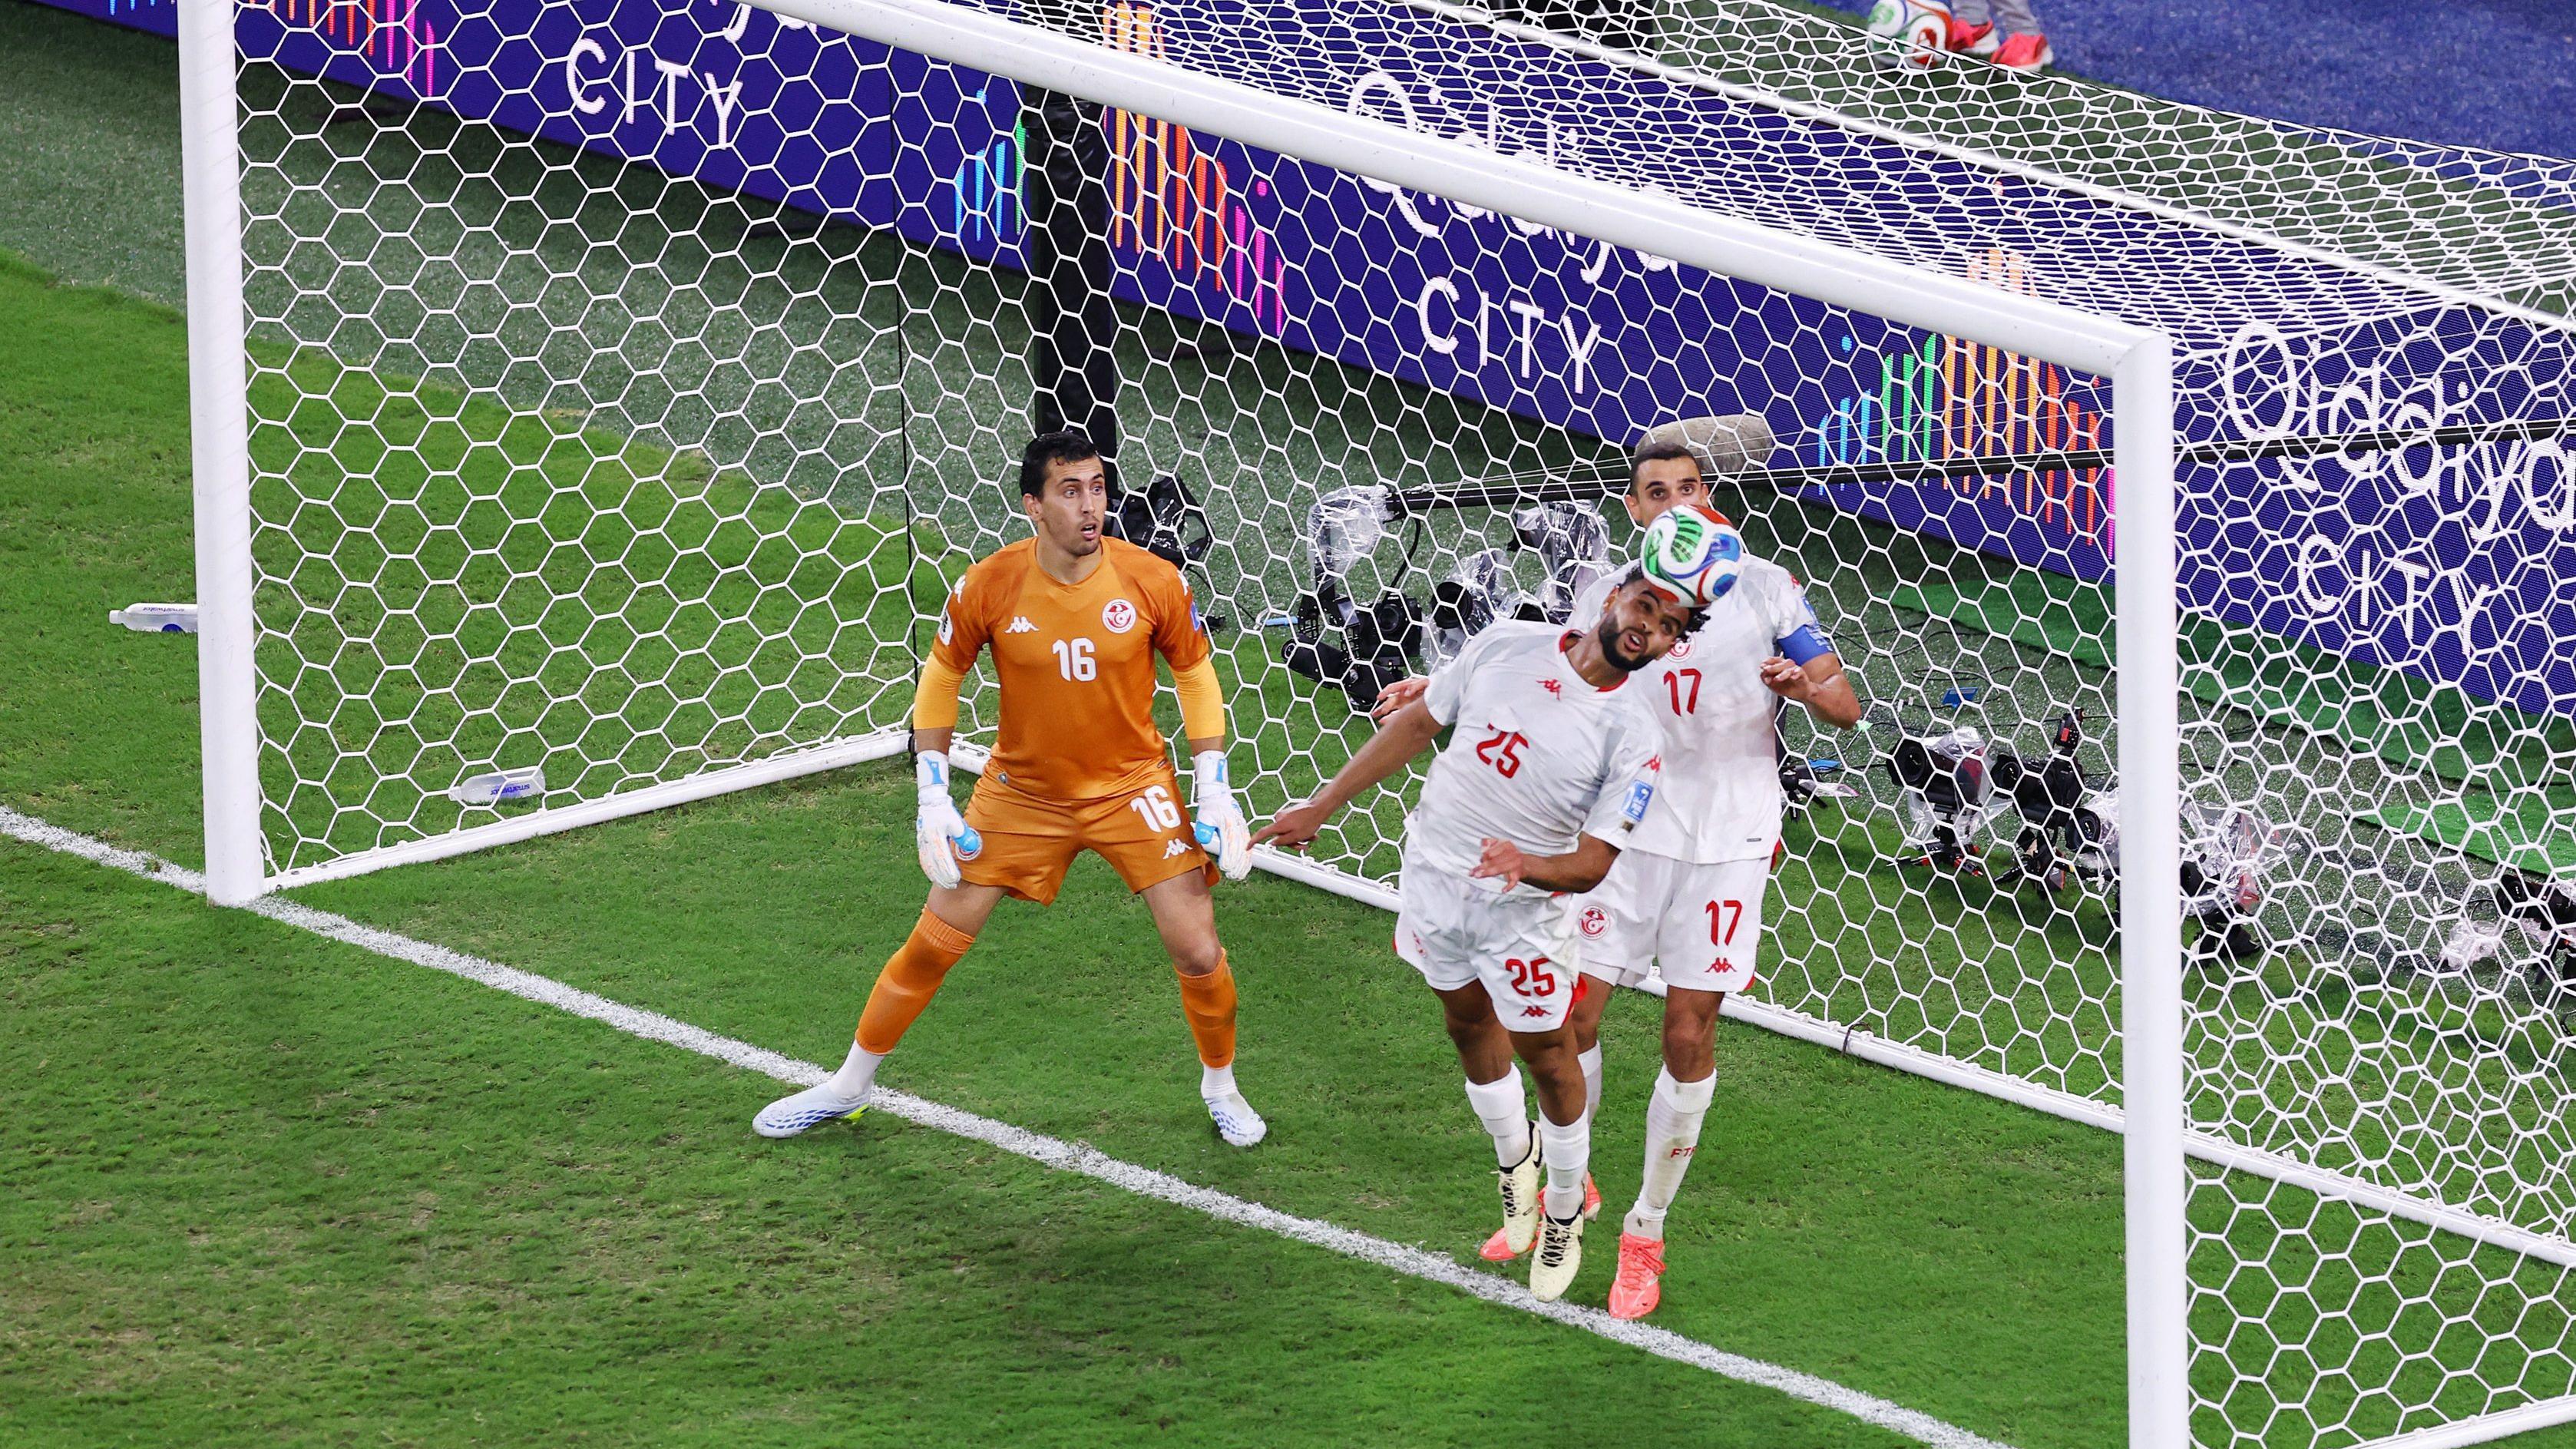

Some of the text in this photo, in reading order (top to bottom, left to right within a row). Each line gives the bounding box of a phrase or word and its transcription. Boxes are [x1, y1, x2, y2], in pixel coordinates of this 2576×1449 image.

[567, 38, 742, 150] CITY
[1420, 276, 1602, 394] CITY
[2298, 534, 2491, 656] CITY
[1052, 637, 1097, 682] 16
[1663, 668, 1702, 717] 17
[1476, 723, 1529, 779] 25
[490, 783, 530, 796] smartwaer
[1130, 785, 1181, 833] 16
[1705, 900, 1742, 947] 17
[1505, 958, 1555, 997] 25
